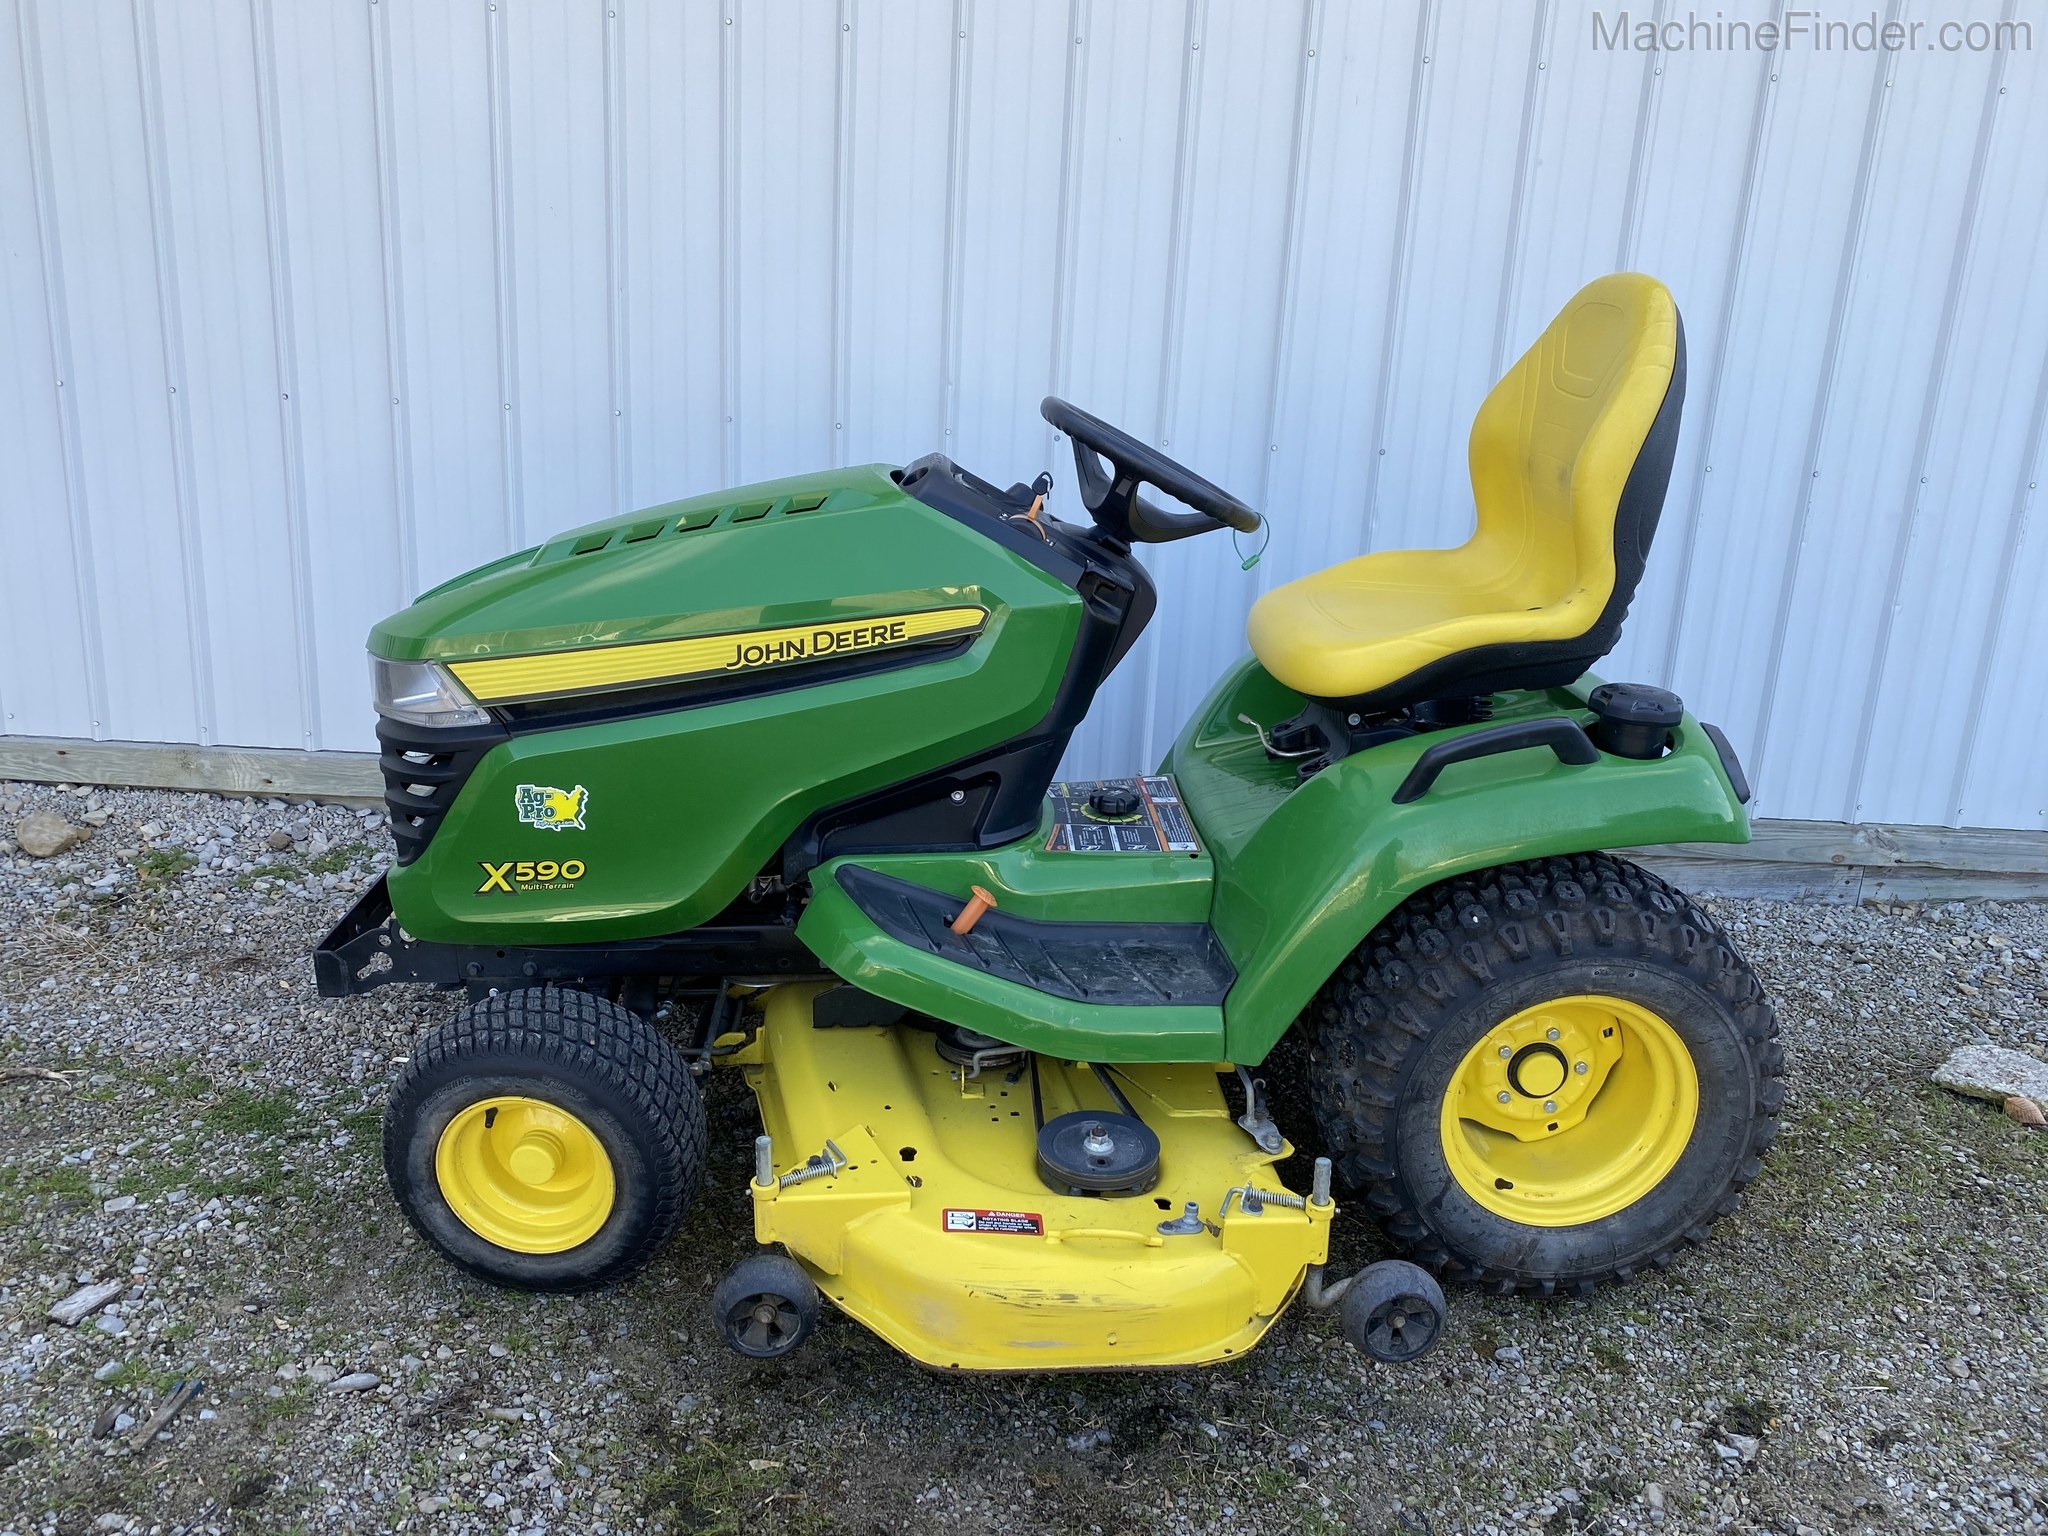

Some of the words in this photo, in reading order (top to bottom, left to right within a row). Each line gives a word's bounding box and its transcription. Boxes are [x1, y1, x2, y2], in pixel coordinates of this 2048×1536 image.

[726, 638, 805, 668] JOHN
[813, 621, 906, 653] DEERE
[522, 804, 555, 819] Pro
[475, 860, 586, 895] X590
